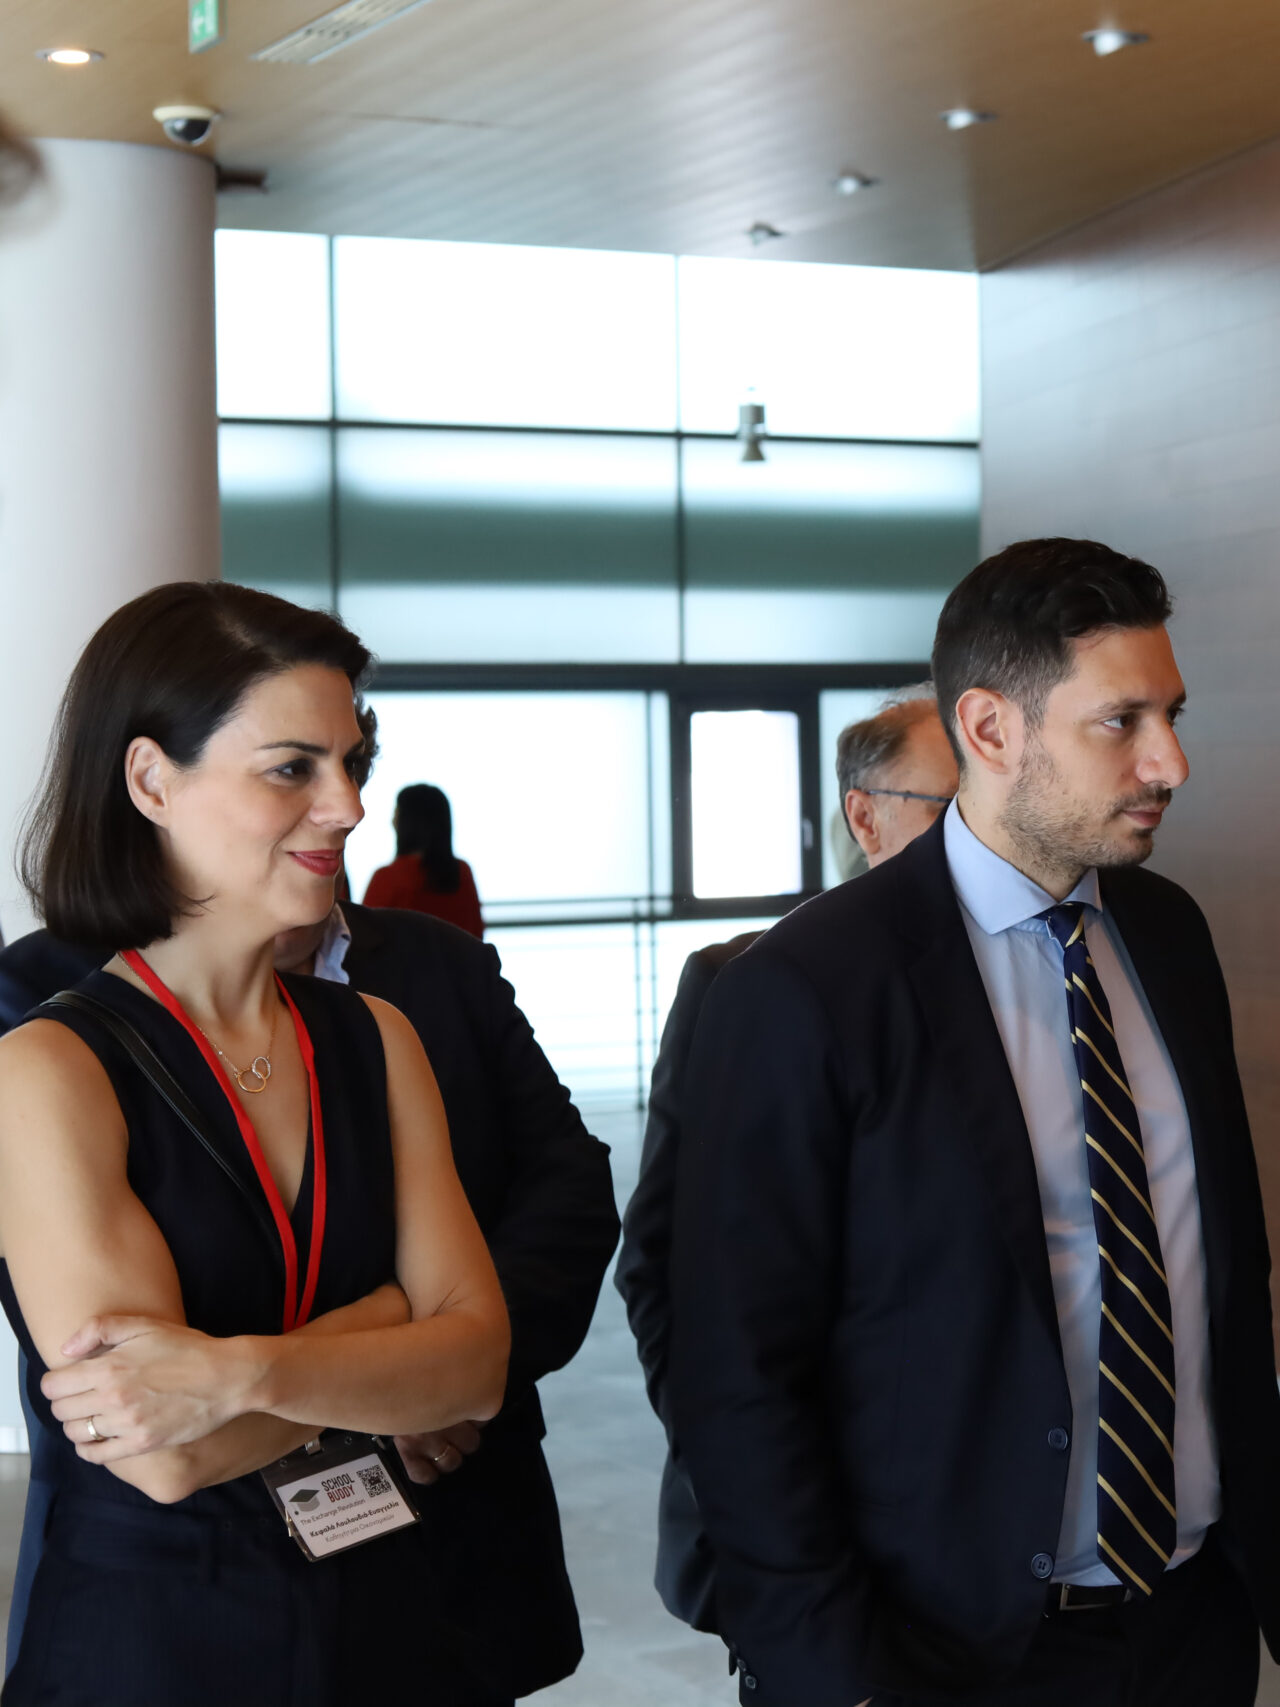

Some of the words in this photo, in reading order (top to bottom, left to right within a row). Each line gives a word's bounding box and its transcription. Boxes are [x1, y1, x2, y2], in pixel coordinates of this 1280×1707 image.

[321, 1472, 355, 1492] SCHOOL
[327, 1484, 355, 1503] BUDDY
[300, 1518, 311, 1526] The
[311, 1508, 338, 1521] Exchange
[337, 1499, 366, 1512] Revolution
[310, 1523, 336, 1538] Κεφαλά
